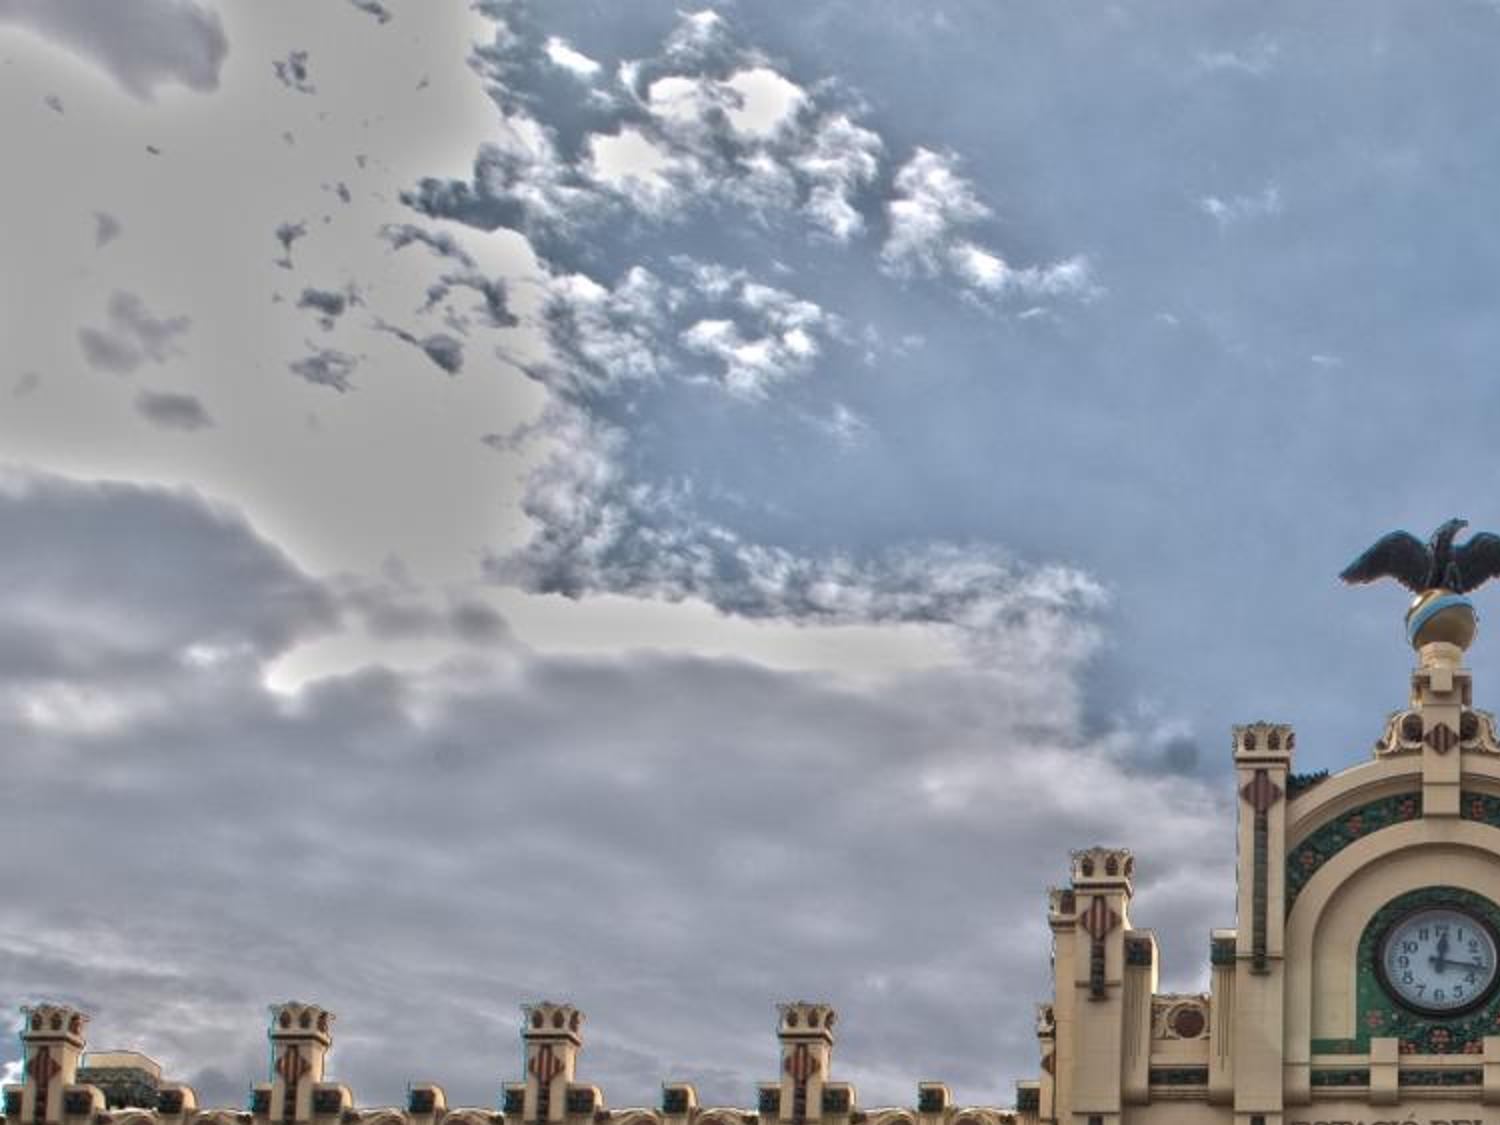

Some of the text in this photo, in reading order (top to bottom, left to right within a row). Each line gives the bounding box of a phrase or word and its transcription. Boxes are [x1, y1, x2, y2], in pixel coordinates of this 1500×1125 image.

[1418, 927, 1429, 941] 11
[1457, 927, 1463, 942] 1
[1401, 941, 1418, 954] 10
[1468, 940, 1479, 953] 2
[1398, 956, 1409, 968] 9
[1402, 971, 1413, 985] 8
[1465, 970, 1475, 985] 4
[1416, 984, 1426, 997] 7
[1434, 988, 1445, 1001] 6
[1454, 985, 1463, 999] 5
